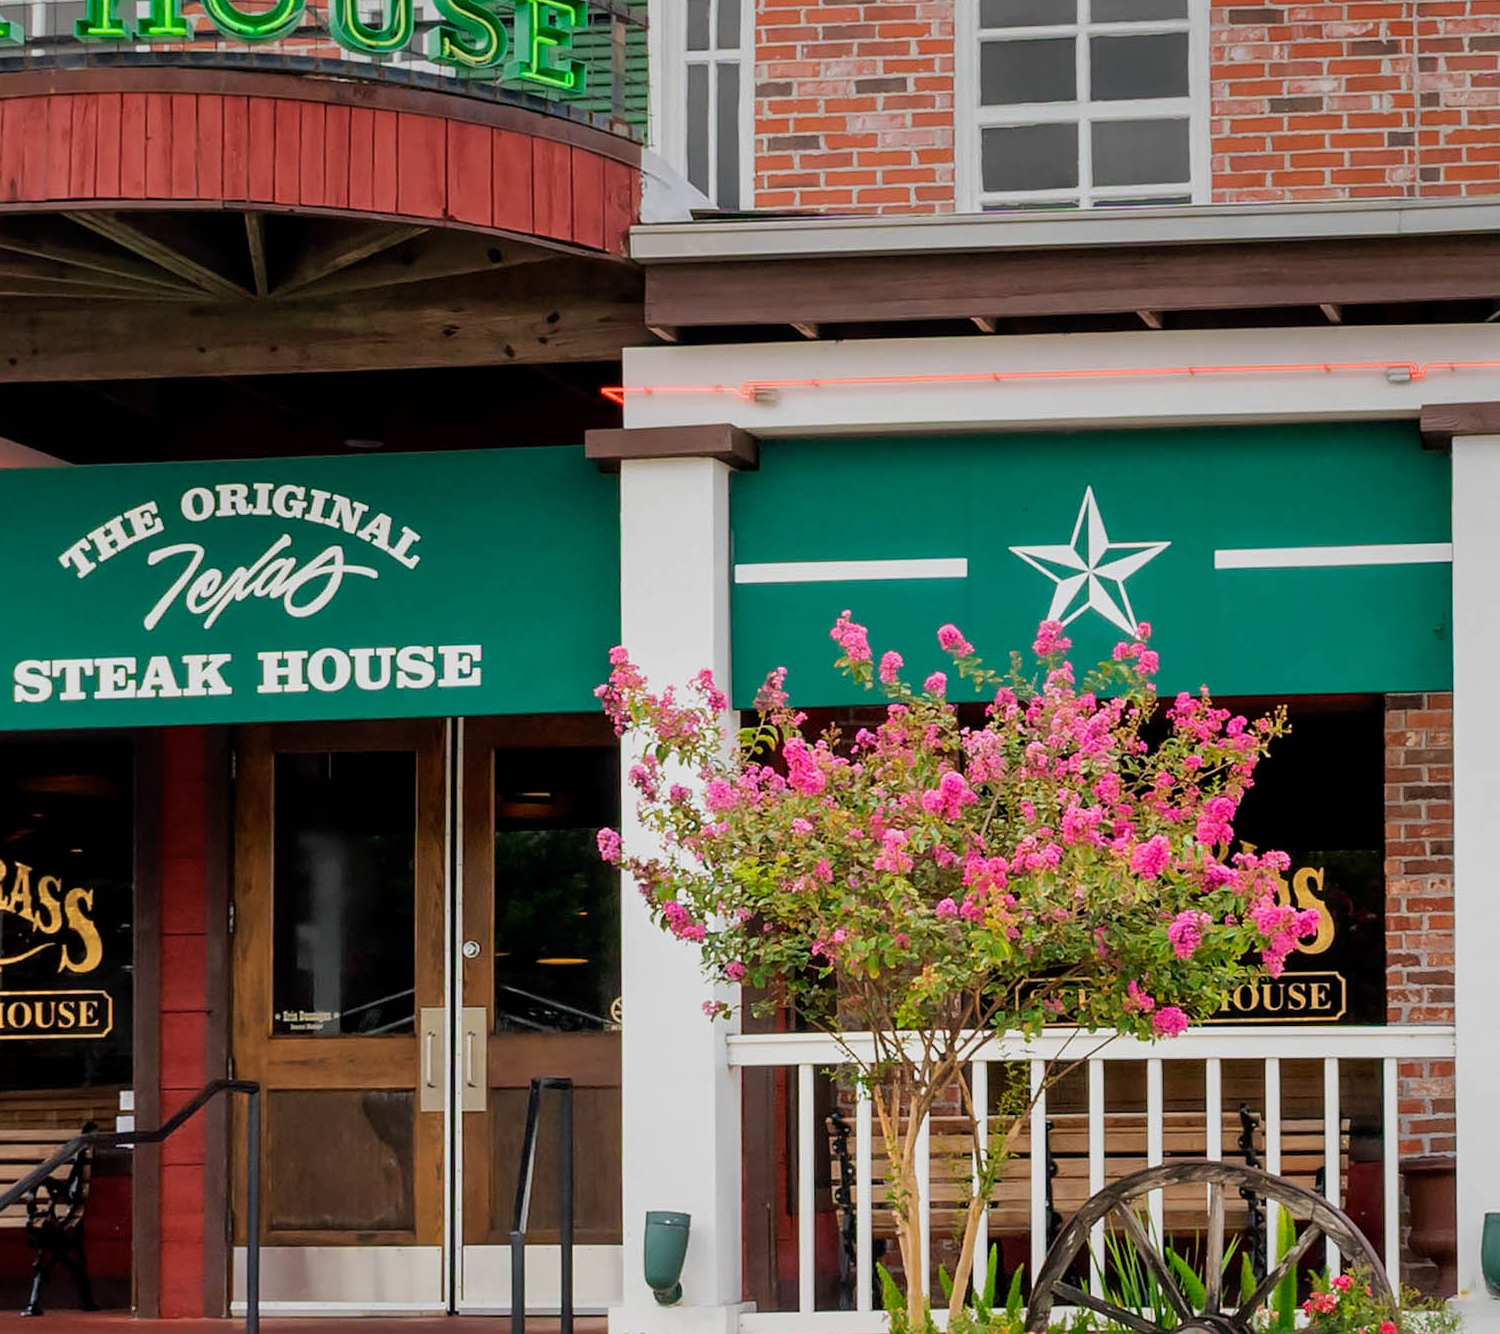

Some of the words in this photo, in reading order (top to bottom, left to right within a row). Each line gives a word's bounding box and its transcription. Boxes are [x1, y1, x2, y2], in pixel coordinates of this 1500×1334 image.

[57, 501, 164, 579] THE
[180, 483, 422, 569] ORIGINAL
[143, 533, 379, 630] Texas
[12, 653, 232, 704] STEAK
[257, 644, 483, 694] HOUSE
